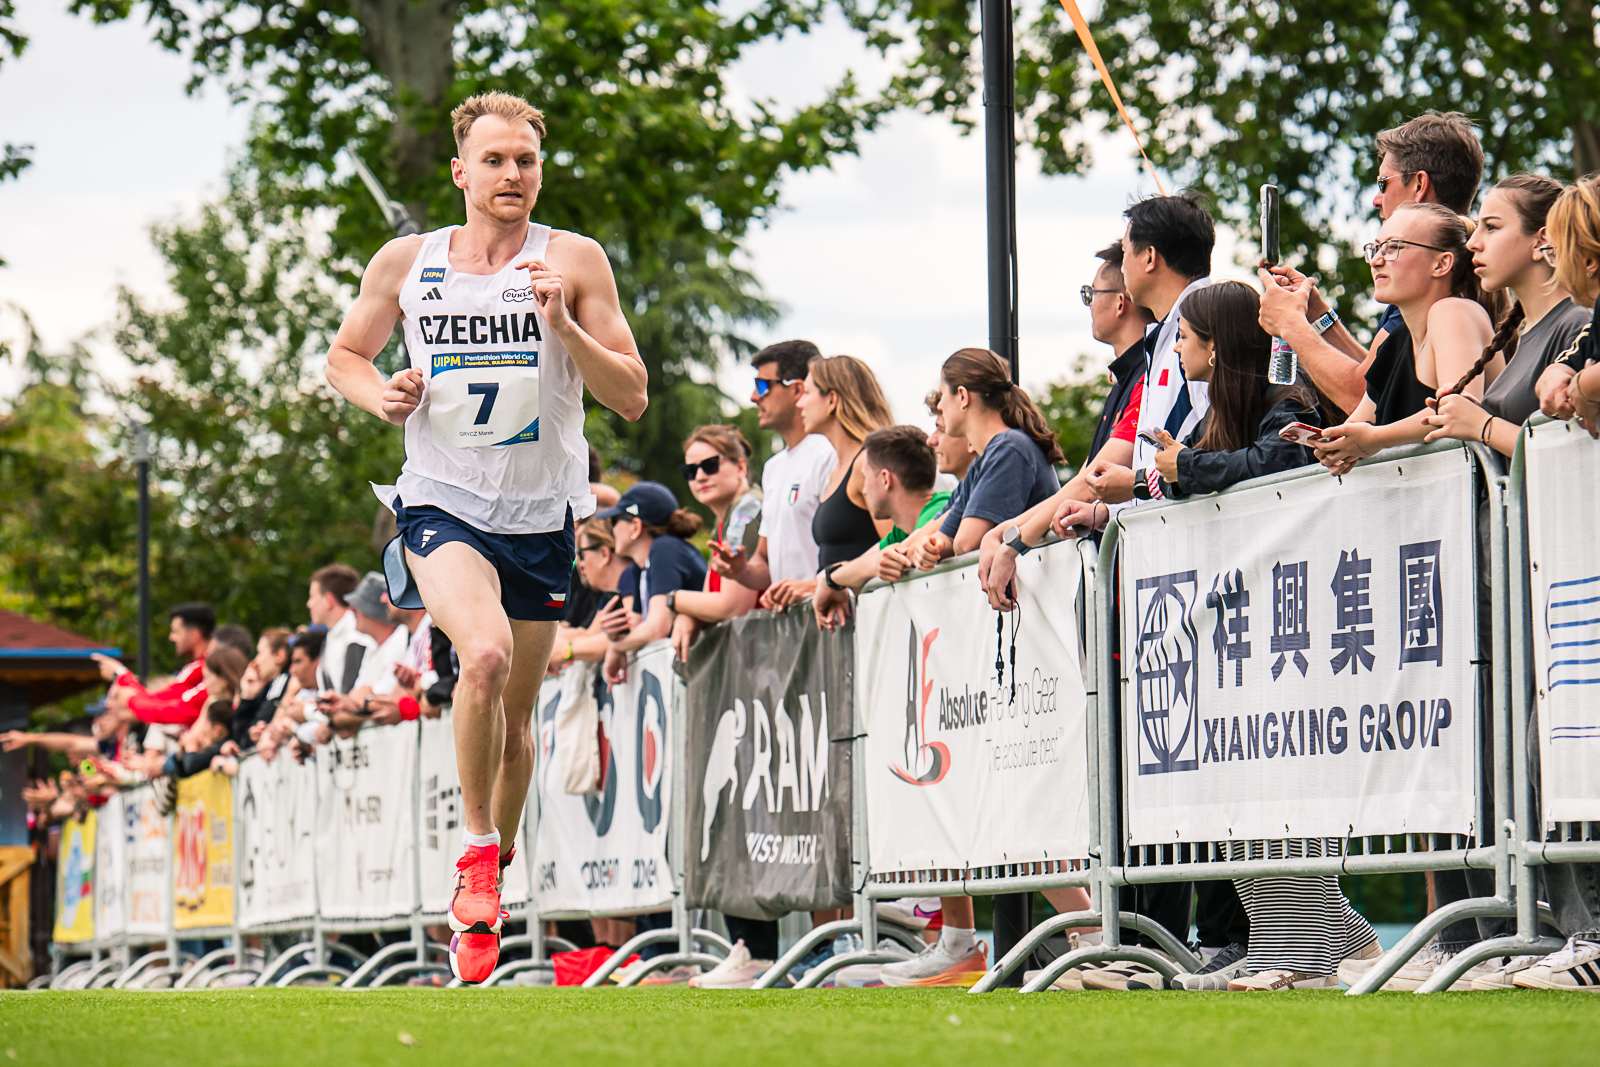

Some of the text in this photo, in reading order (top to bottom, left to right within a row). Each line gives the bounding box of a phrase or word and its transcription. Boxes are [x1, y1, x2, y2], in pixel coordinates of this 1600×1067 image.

[423, 271, 444, 279] UIPM
[419, 311, 542, 345] CZECHIA
[433, 355, 461, 368] UIPM
[521, 353, 534, 362] Cup
[468, 382, 499, 425] 7
[1206, 539, 1443, 689] 祥興集團
[939, 683, 988, 731] Absolute
[1032, 667, 1059, 715] Gear
[742, 690, 830, 813] RAM
[1202, 698, 1452, 763] XIANGXING GROUP
